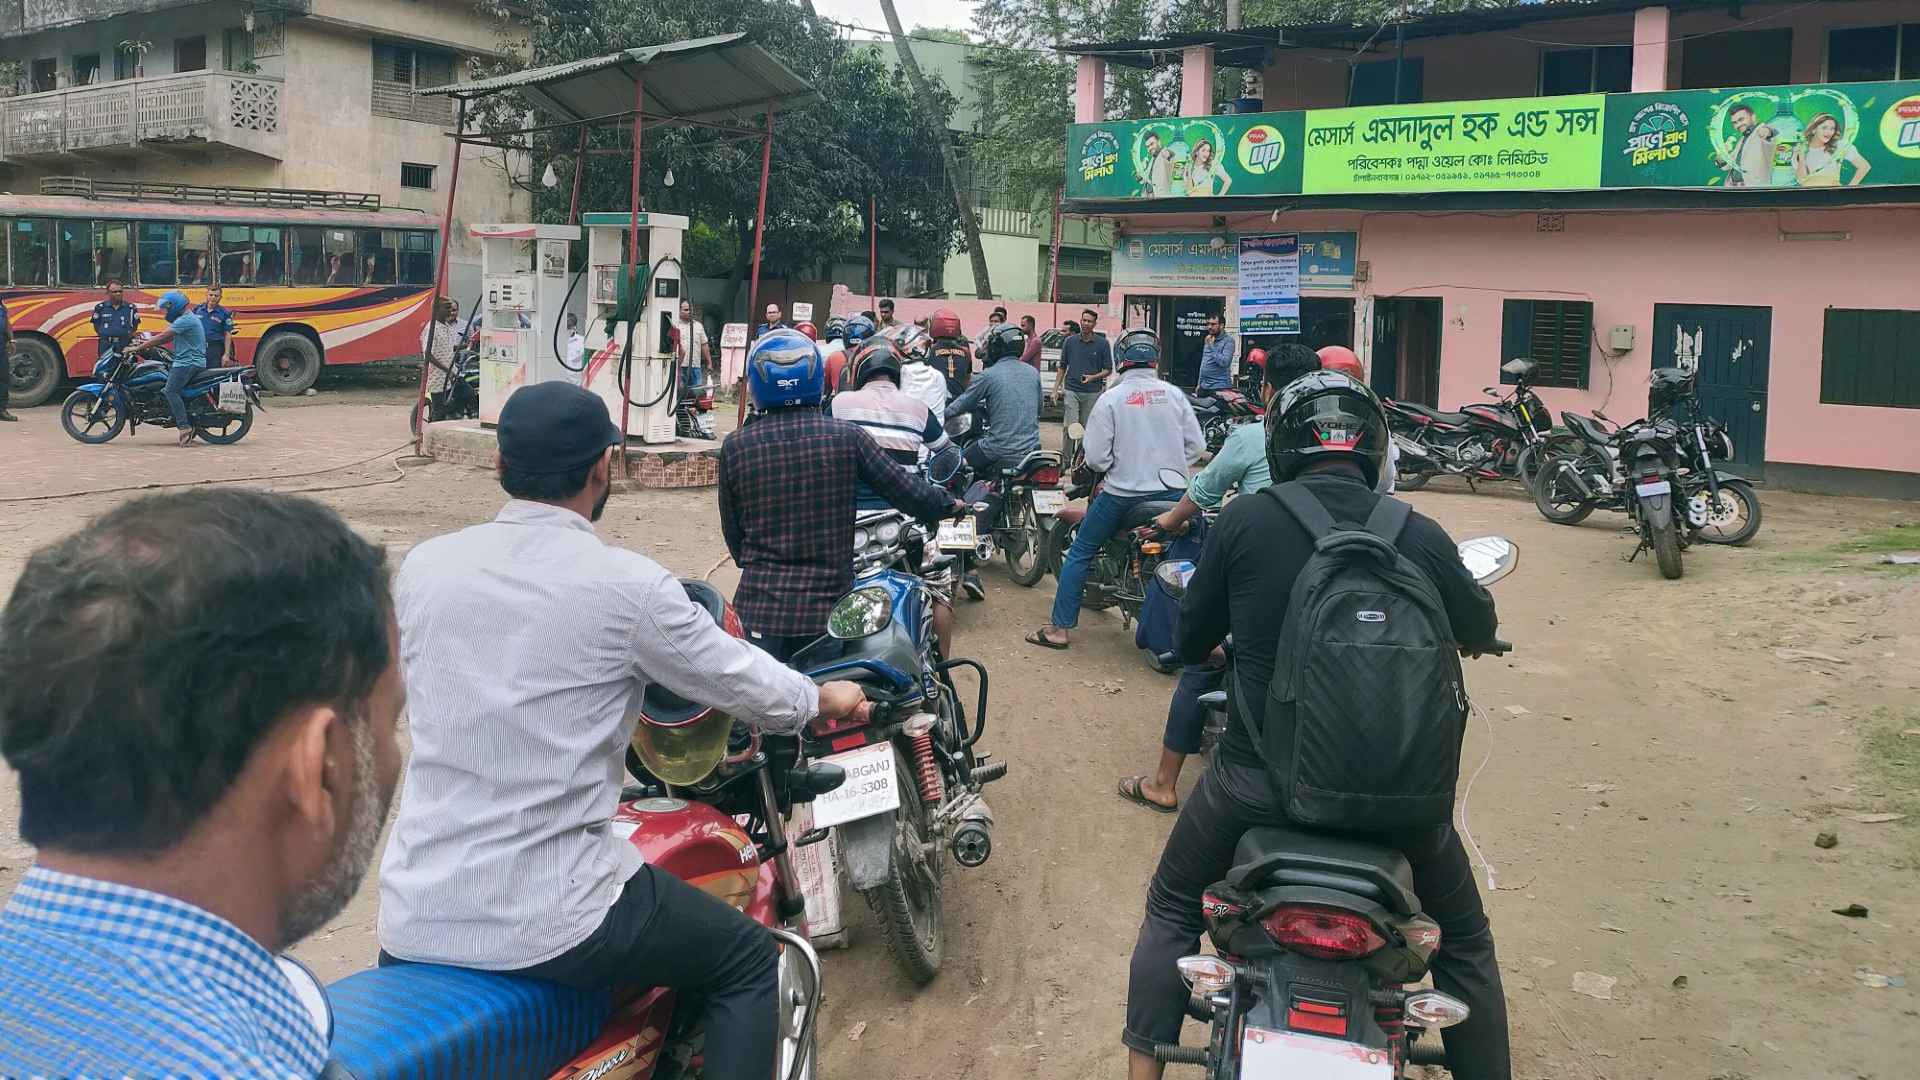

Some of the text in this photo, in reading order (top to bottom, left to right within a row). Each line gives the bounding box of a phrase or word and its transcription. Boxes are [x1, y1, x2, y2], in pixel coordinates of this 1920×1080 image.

[1307, 122, 1354, 147] মেসার্স
[1362, 114, 1454, 150] এমদাদুল
[1462, 112, 1499, 141] হক
[1556, 108, 1600, 135] সন্স
[1407, 156, 1428, 170] পদ্মা
[1497, 150, 1548, 166] লিমিটেড
[1148, 239, 1184, 258] মেসার্স
